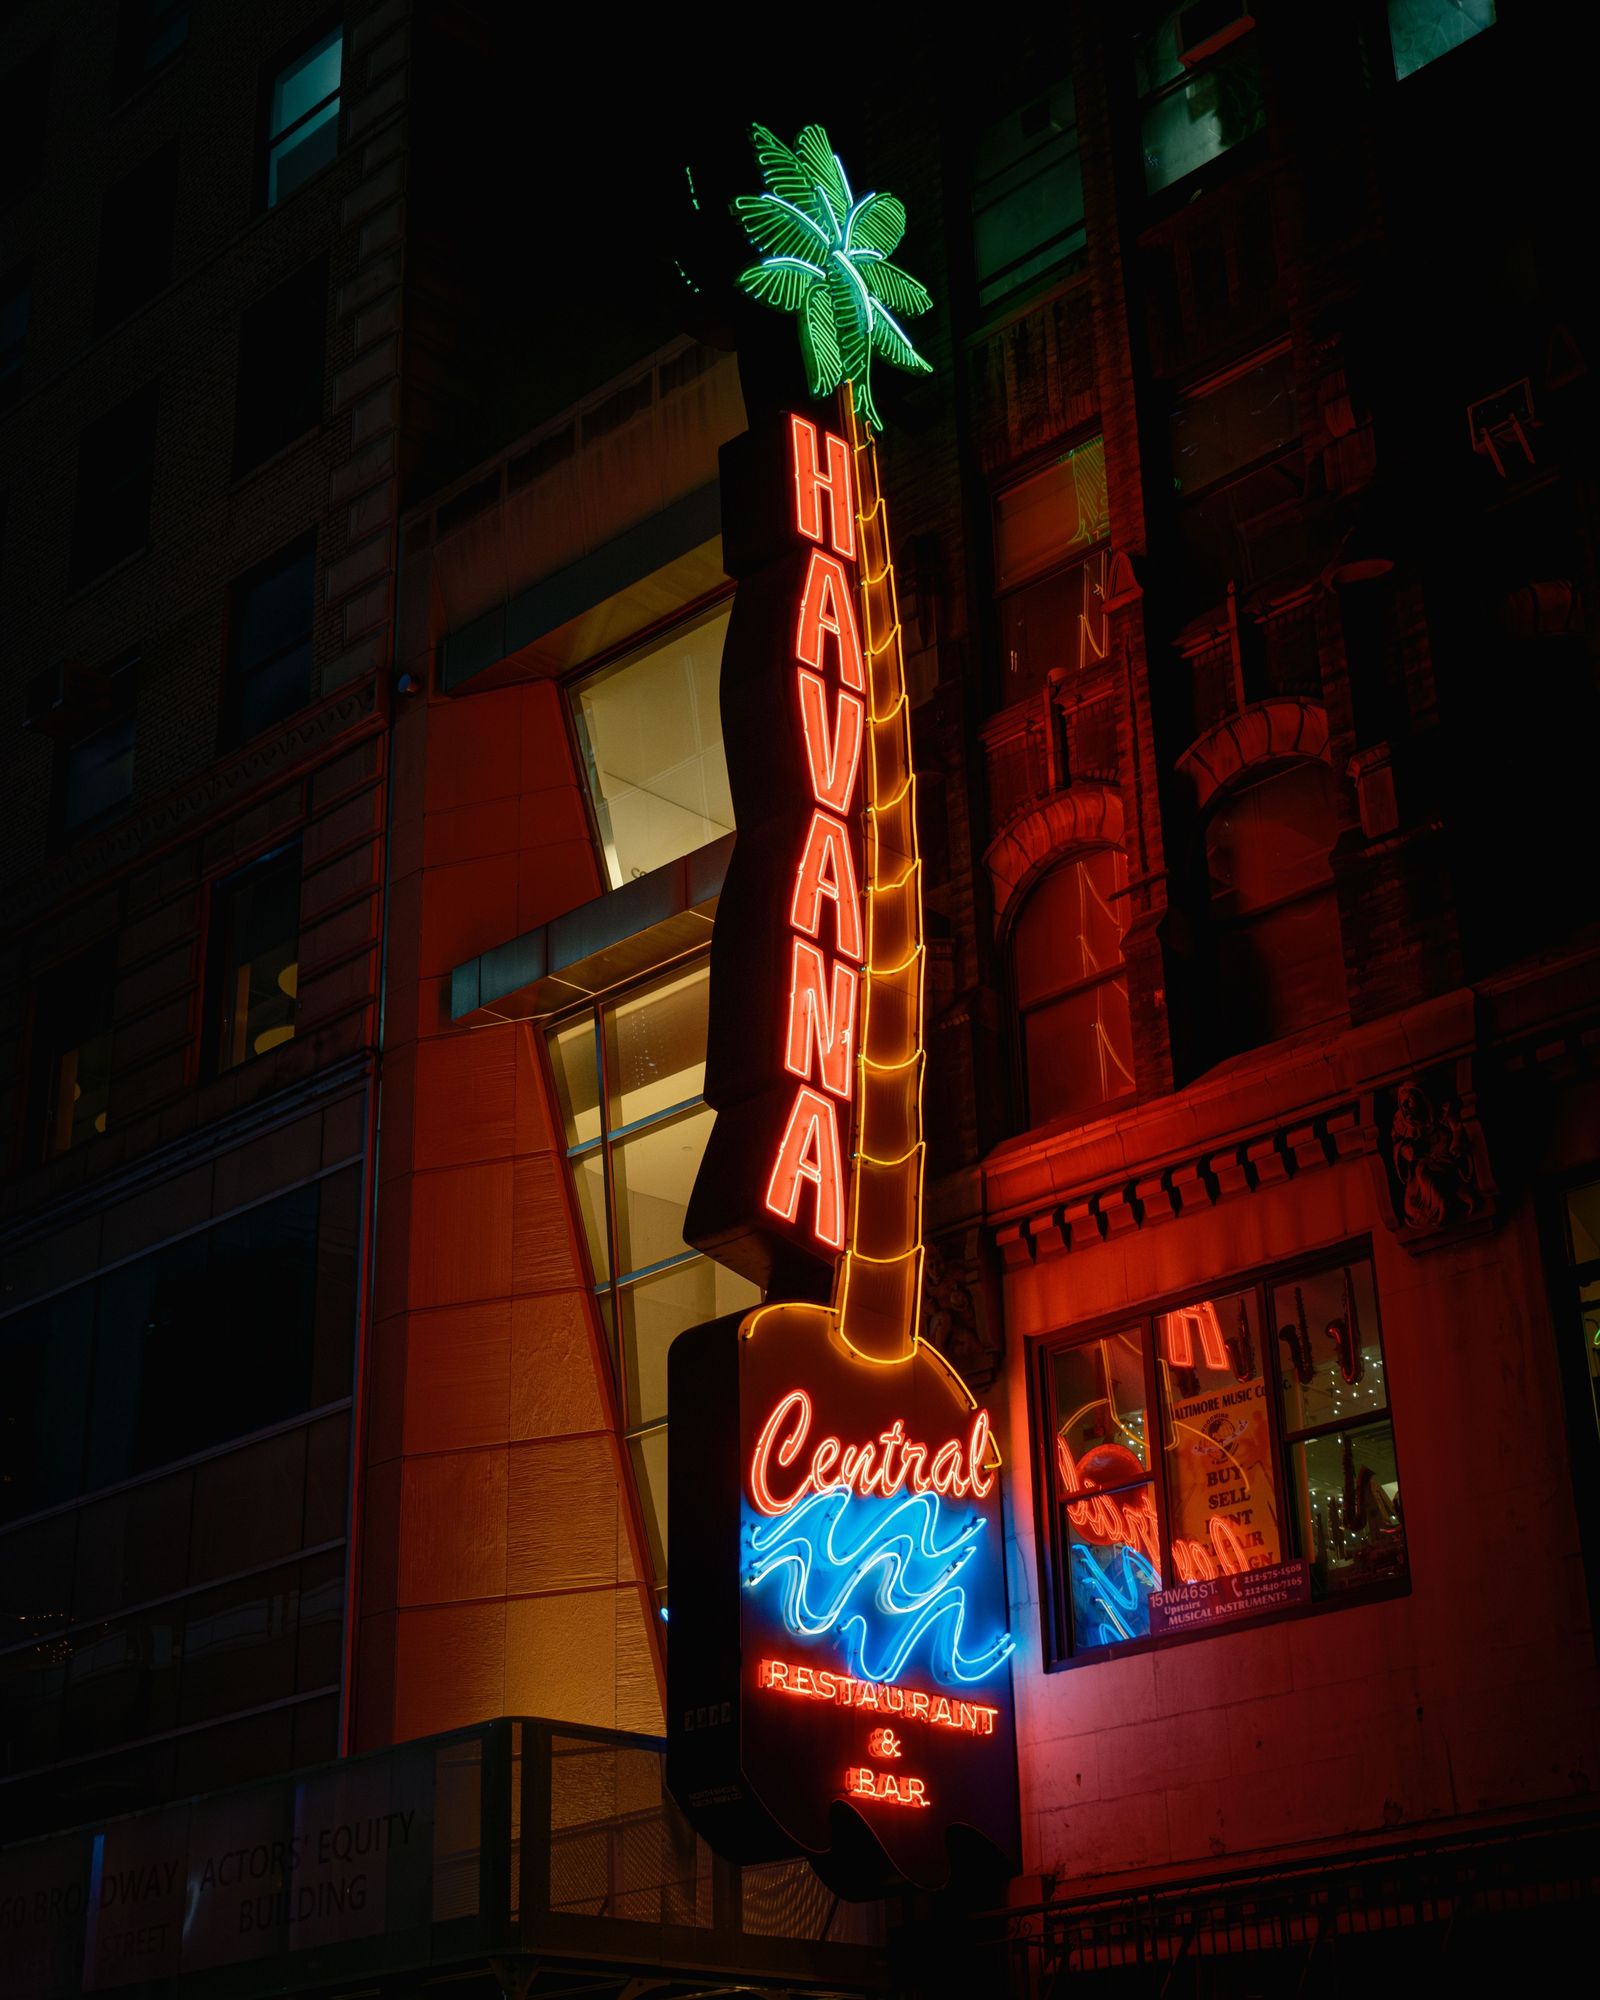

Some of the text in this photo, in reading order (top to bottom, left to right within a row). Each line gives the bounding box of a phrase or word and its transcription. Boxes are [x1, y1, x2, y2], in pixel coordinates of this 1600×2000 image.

[764, 413, 866, 1251] HAVANA
[1222, 1387, 1252, 1407] MUSIC
[749, 1388, 997, 1517] Central
[1206, 1464, 1243, 1487] BUY
[1208, 1487, 1251, 1509] SELL
[1164, 1601, 1201, 1616] Upstairs
[1168, 1591, 1287, 1626] MUSICAL INSTRUMENTS
[758, 1658, 998, 1736] RESTAURANT
[868, 1727, 902, 1758] &
[846, 1767, 931, 1807] BAR
[318, 1810, 415, 1864] EQUITY
[239, 1874, 367, 1934] BUILDING
